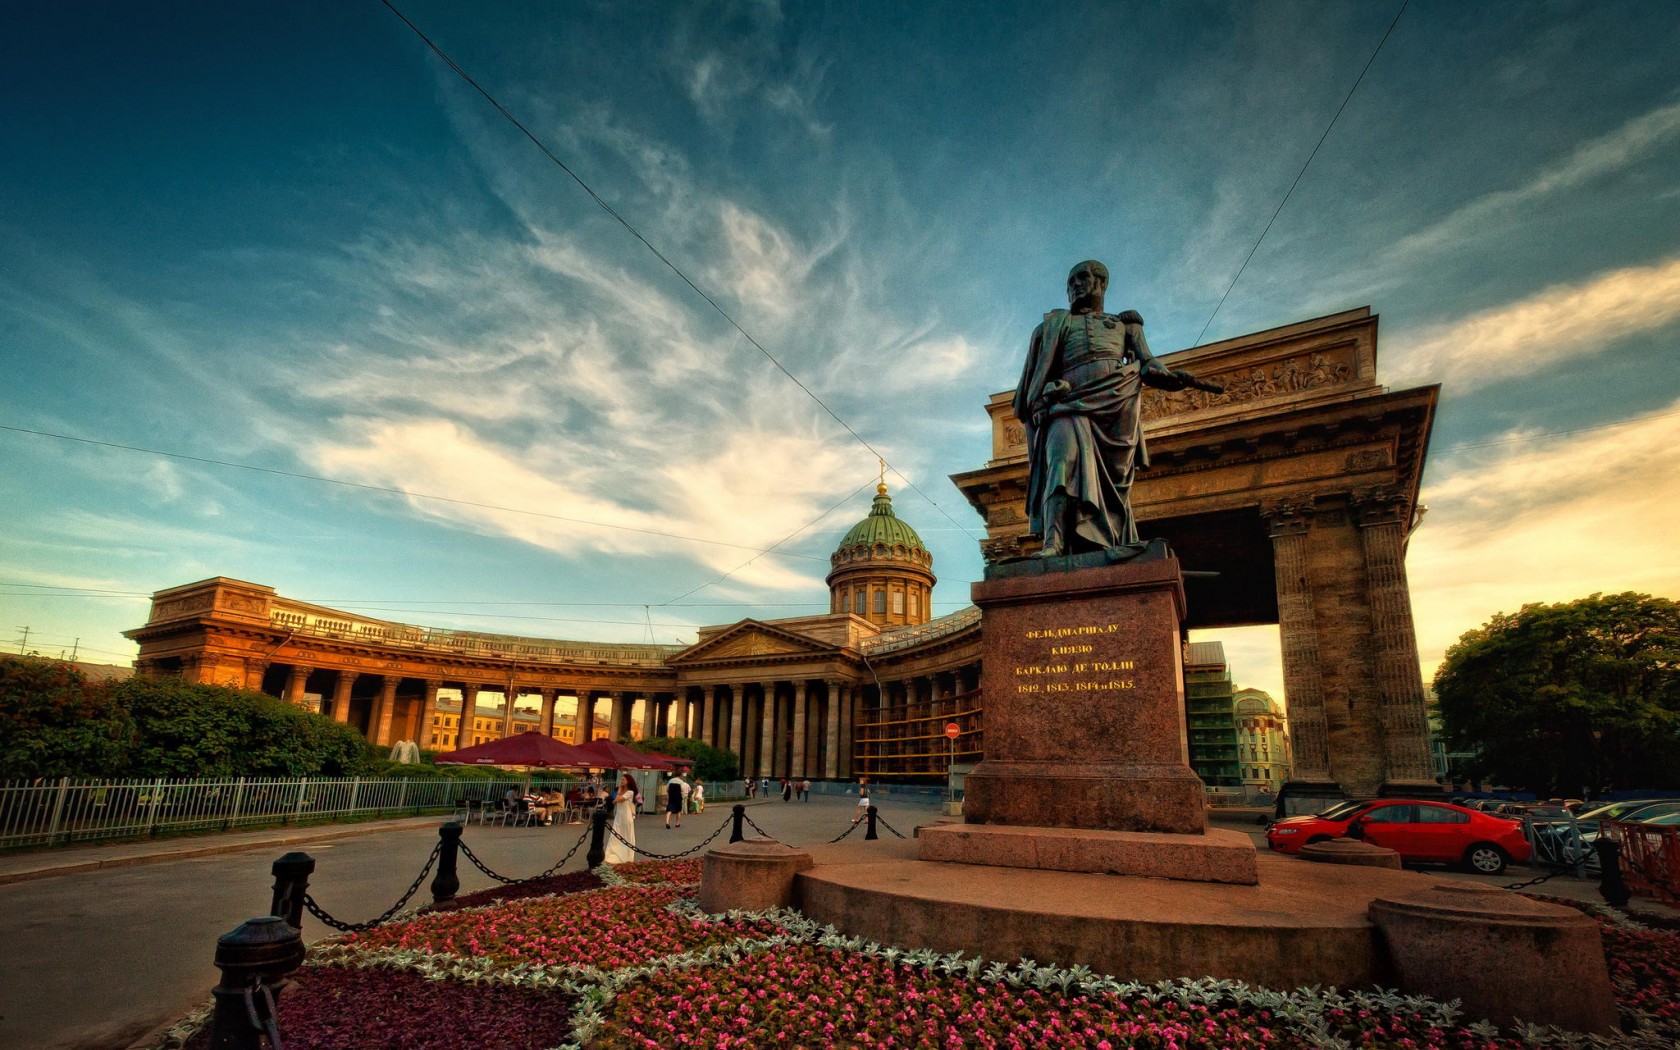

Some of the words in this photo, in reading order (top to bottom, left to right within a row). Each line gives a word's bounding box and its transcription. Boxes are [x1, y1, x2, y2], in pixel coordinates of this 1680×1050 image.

[1026, 624, 1119, 639] ФЕЛЬДМАРШАЛУ
[1051, 645, 1093, 655] КНЯЗЮ
[1016, 664, 1068, 675] БАРКЛАЮ
[1072, 663, 1088, 674] ДЕ
[1091, 661, 1134, 672] ТОЛЛИ
